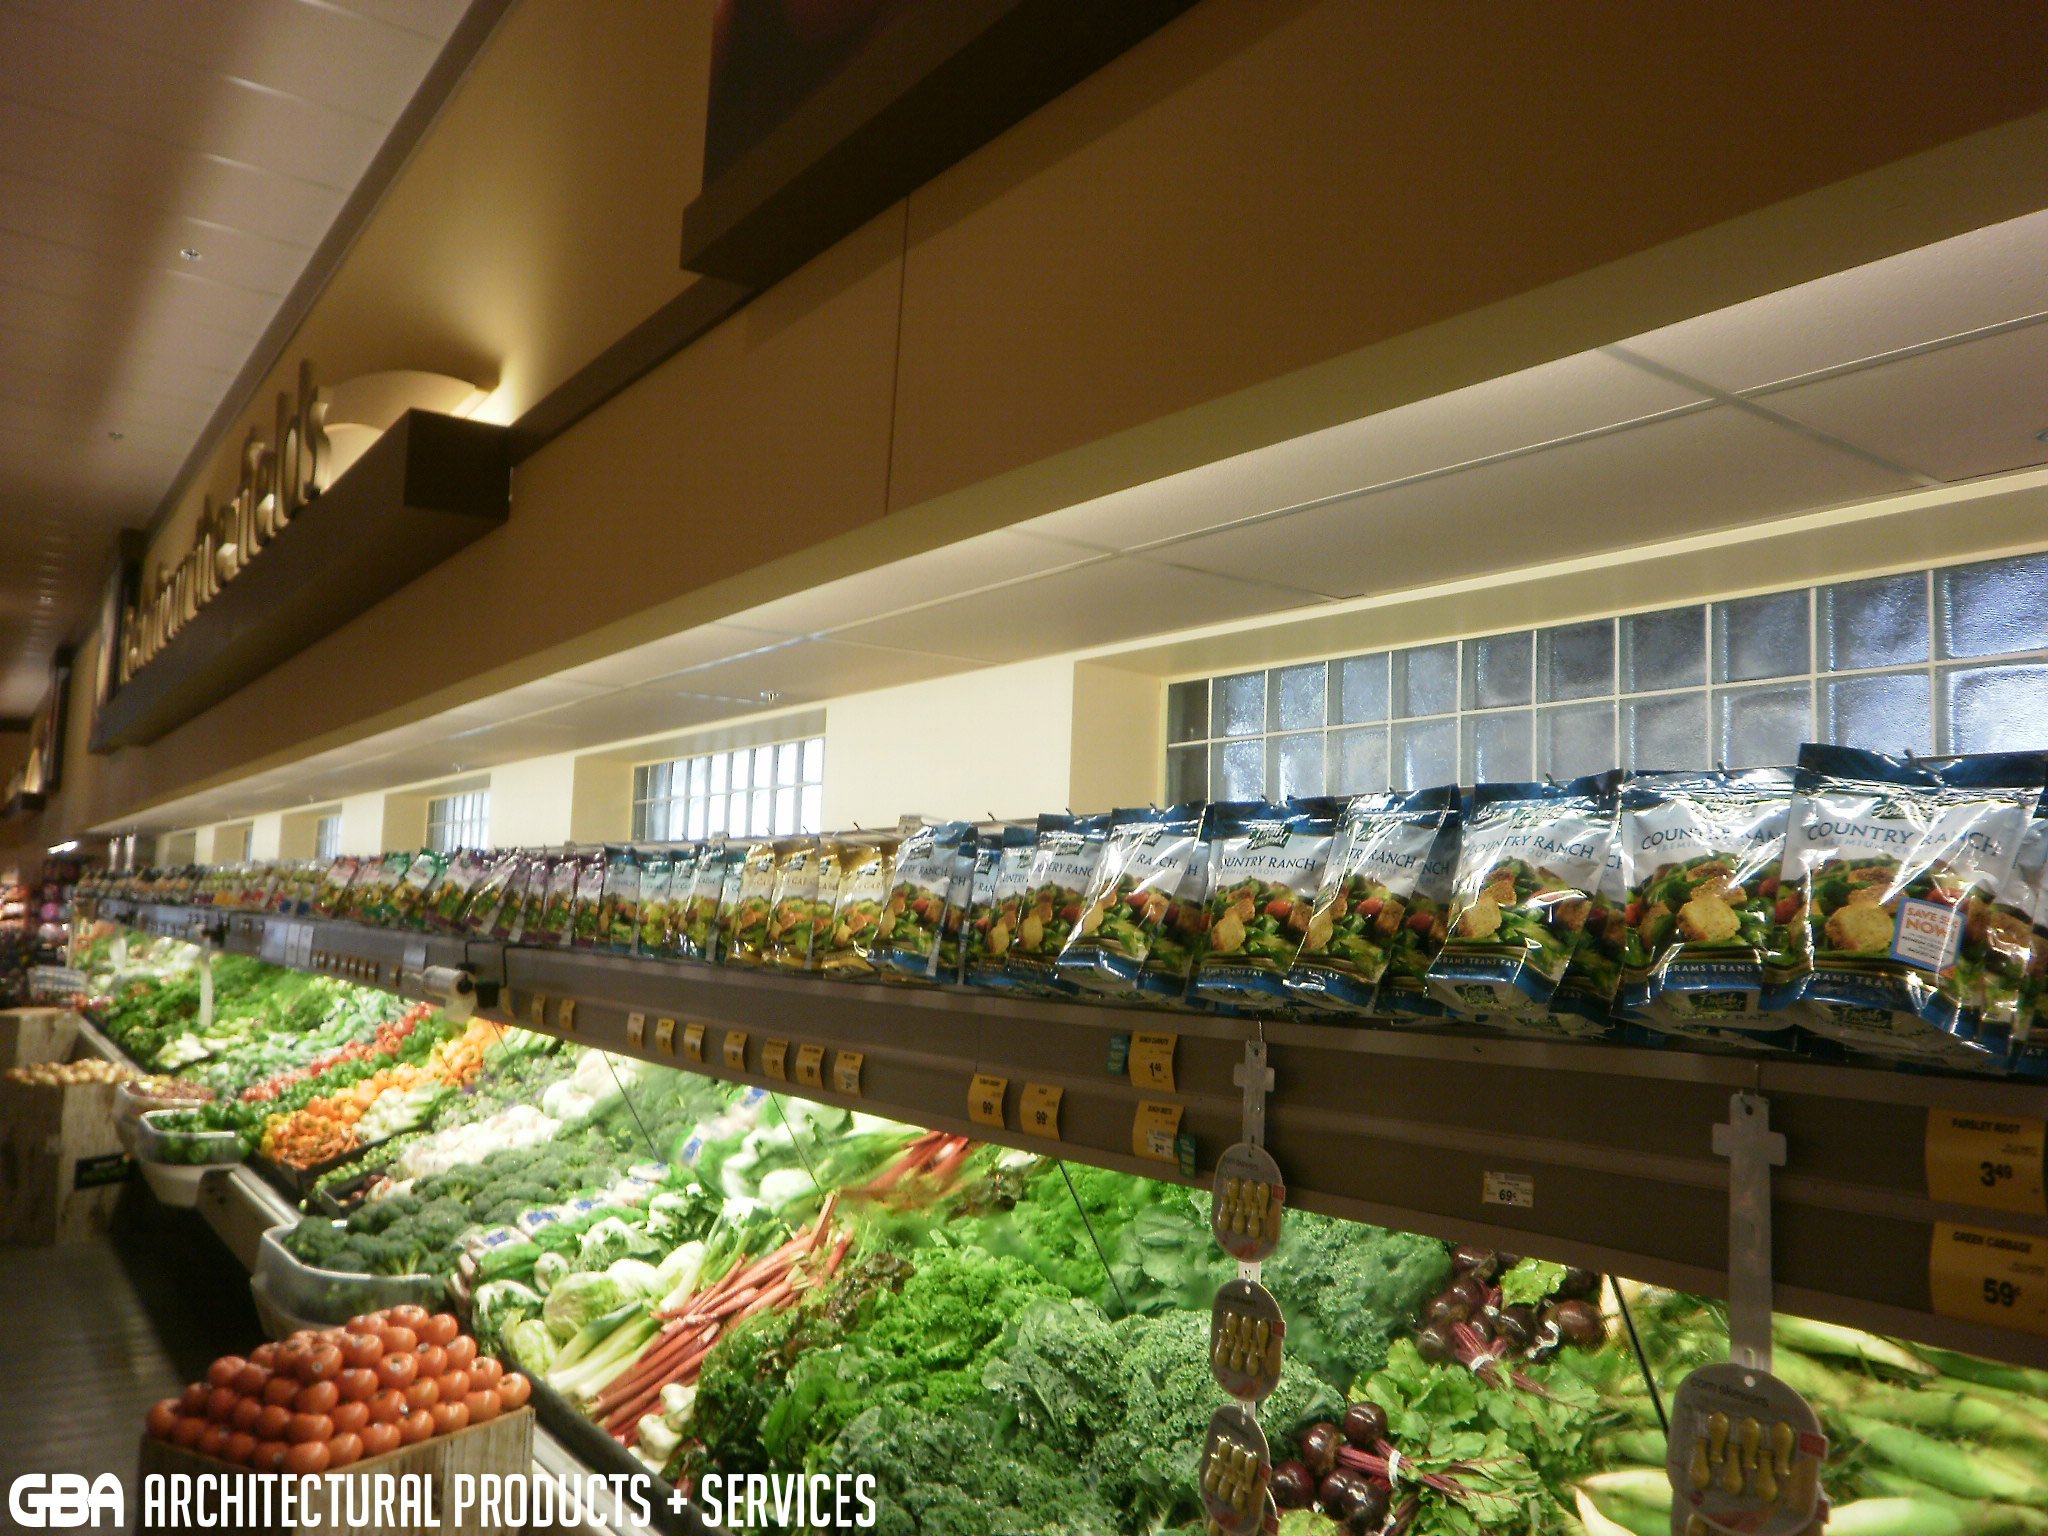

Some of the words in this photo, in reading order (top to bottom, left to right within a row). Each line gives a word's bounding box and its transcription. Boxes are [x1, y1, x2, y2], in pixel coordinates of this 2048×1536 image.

[1807, 821, 1914, 845] COUNTRY
[1533, 835, 1595, 859] RANCH
[1136, 852, 1179, 869] RACH
[1268, 856, 1316, 872] RANCH
[1422, 861, 1450, 876] NCH
[1066, 861, 1094, 877] RANC
[978, 883, 994, 893] RAN
[1907, 907, 1938, 921] SAVE
[1905, 918, 1949, 938] NOW
[1500, 960, 1519, 968] FAT
[1711, 963, 1753, 974] TRANS
